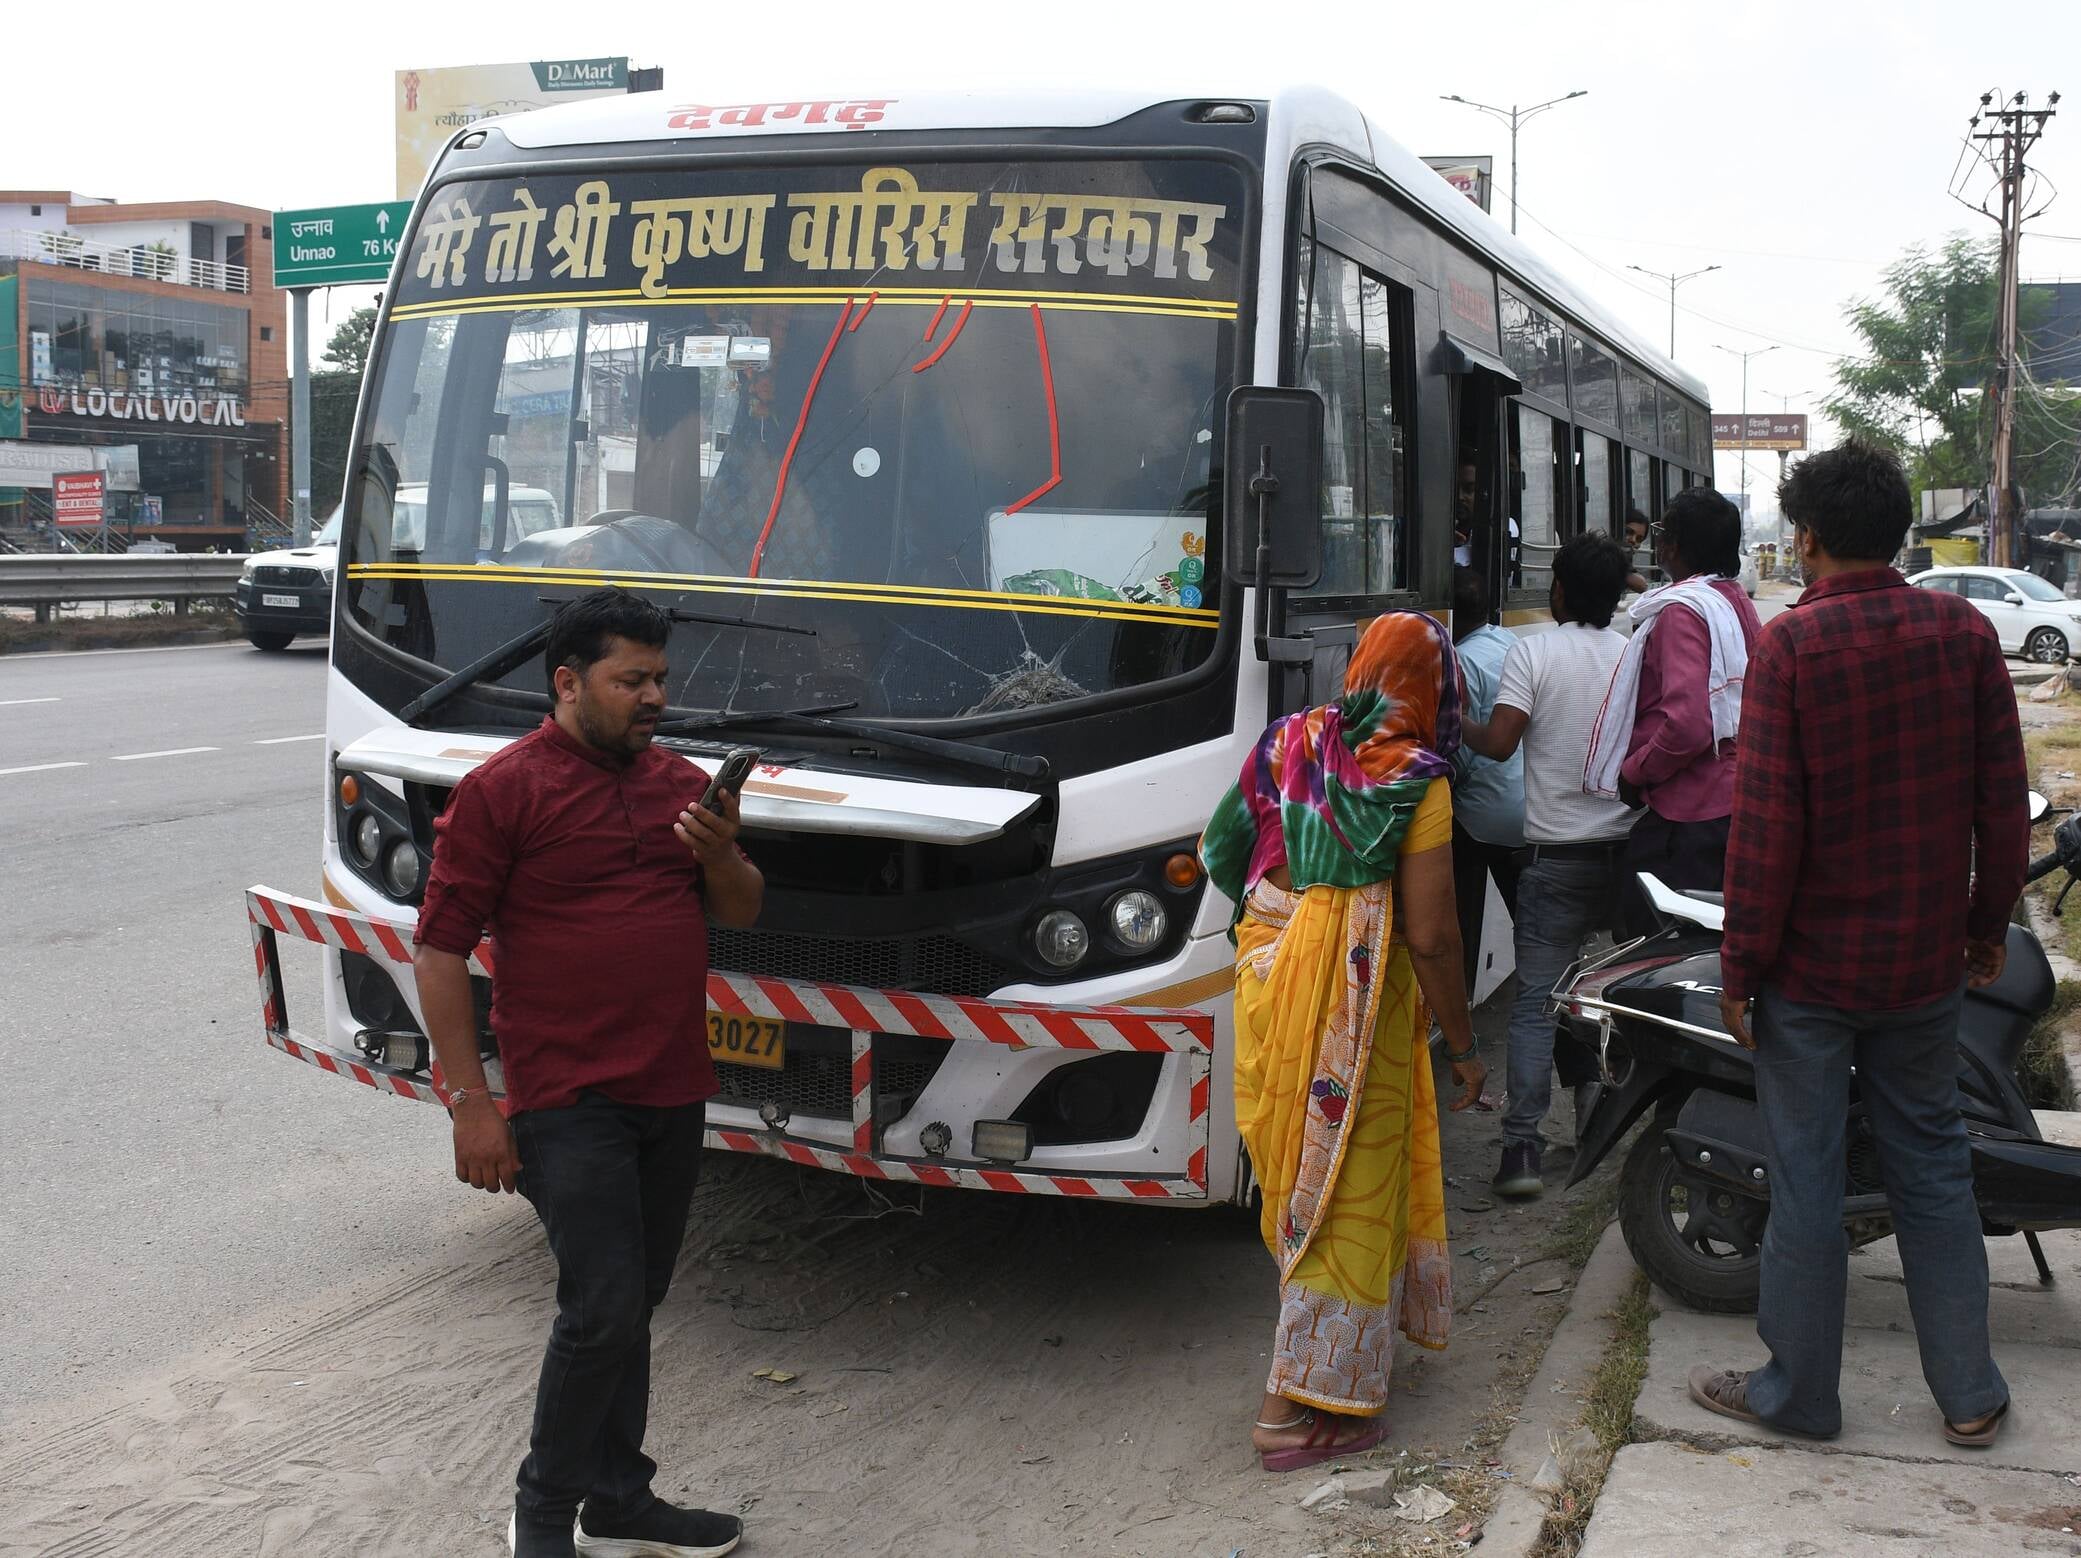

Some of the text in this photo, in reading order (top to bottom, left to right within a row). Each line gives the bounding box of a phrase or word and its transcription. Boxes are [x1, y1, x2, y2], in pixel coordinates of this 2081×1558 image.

[290, 219, 334, 239] उन्नाव
[416, 168, 1226, 299] मेरे तो श्री कृष्ण वारिस सरकार
[290, 245, 336, 262] Unnao
[362, 239, 380, 257] 76
[71, 385, 245, 426] LOCAL VOCAL
[1747, 429, 1770, 437] Delhi
[708, 1015, 780, 1057] 3027
